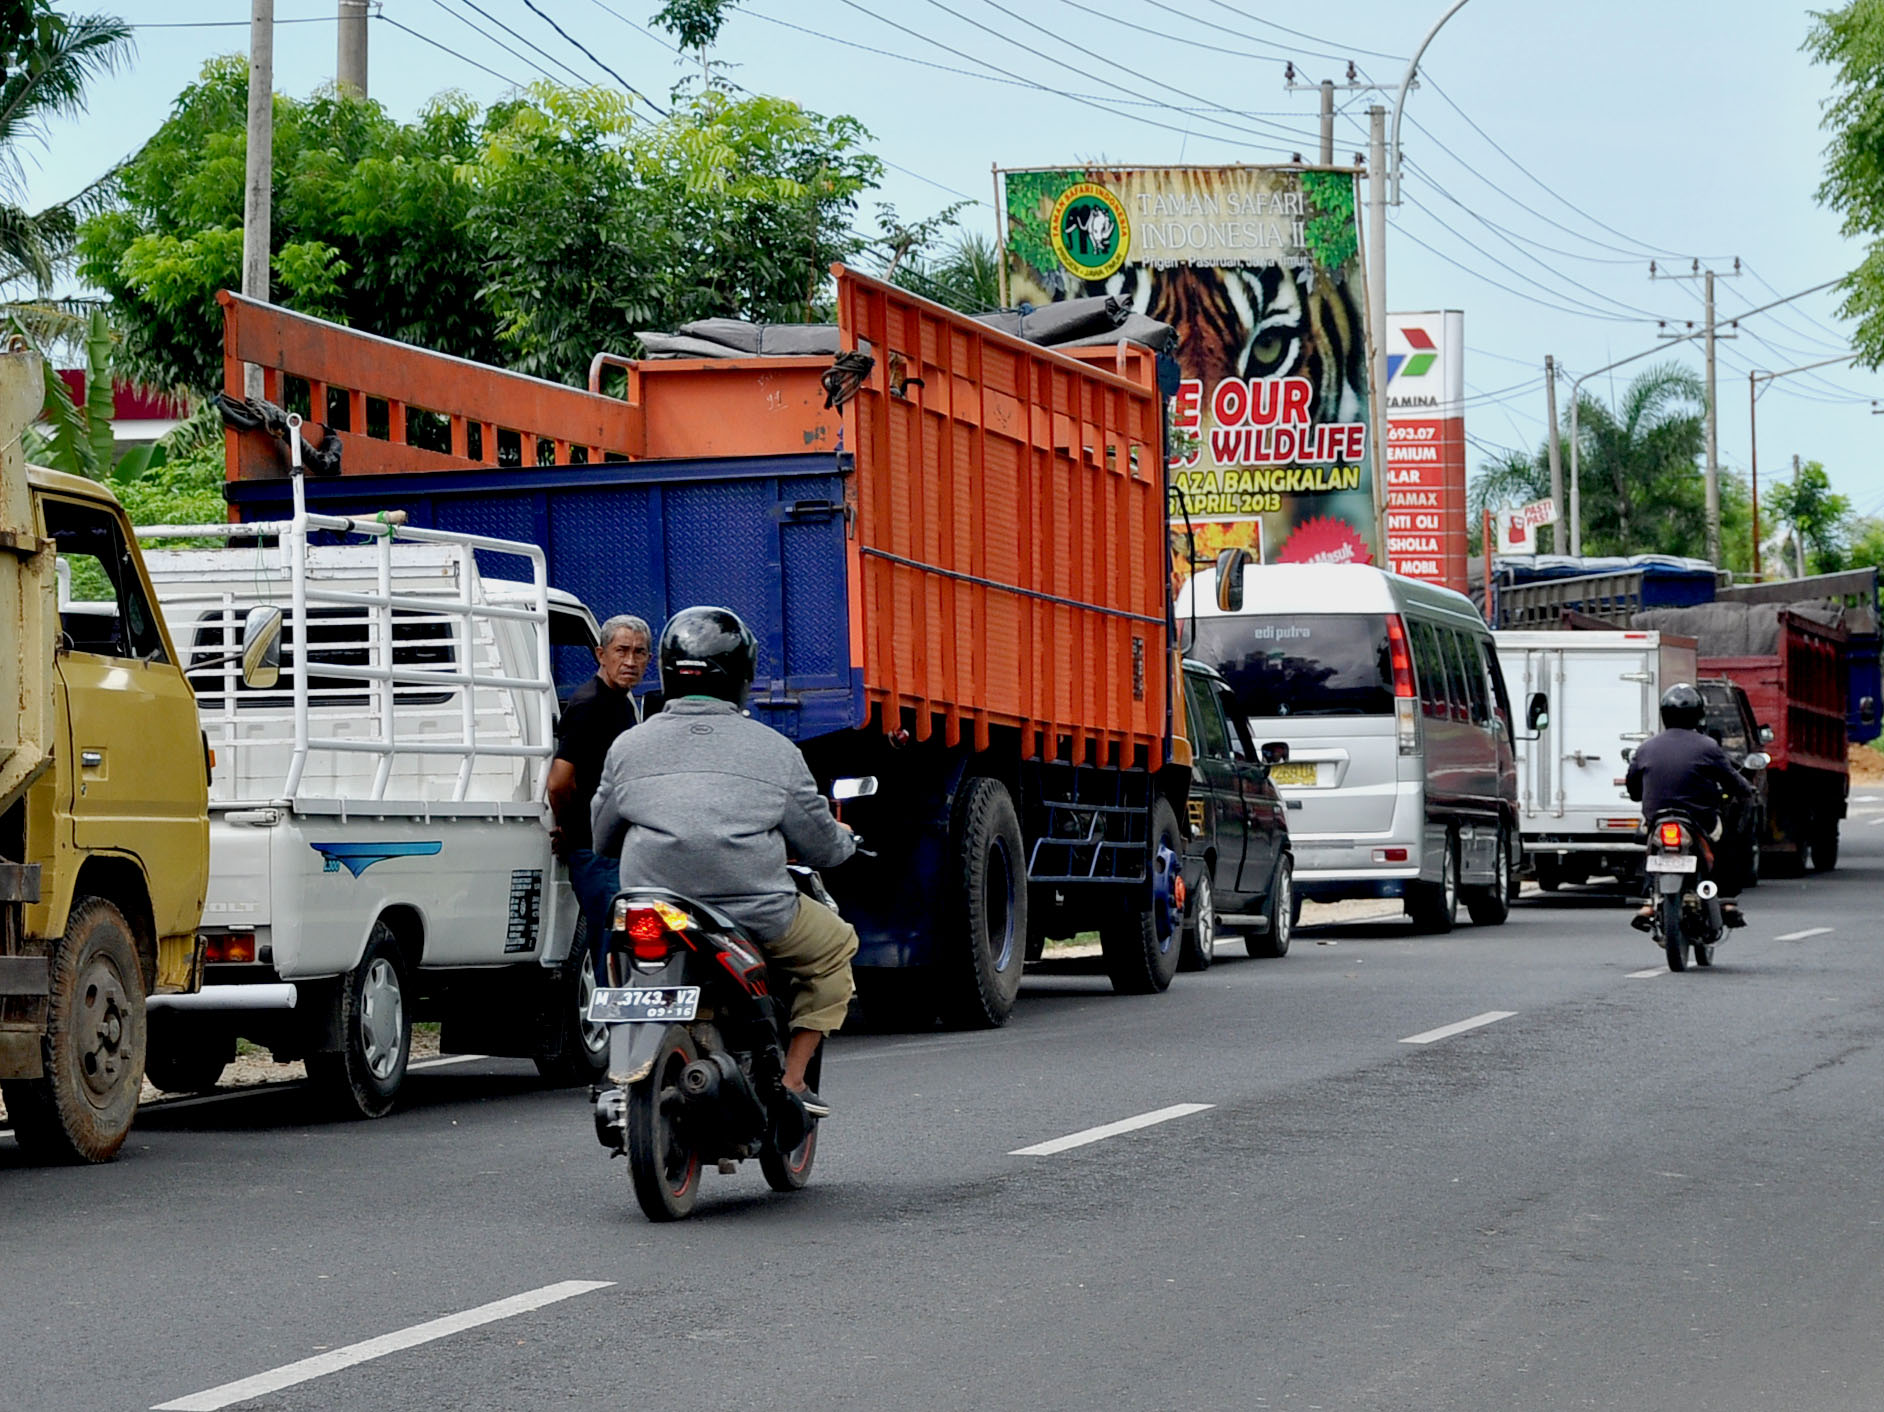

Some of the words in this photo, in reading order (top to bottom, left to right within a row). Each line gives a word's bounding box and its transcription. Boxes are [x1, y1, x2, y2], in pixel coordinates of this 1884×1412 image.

[1136, 192, 1220, 216] TAMAN
[1227, 192, 1304, 216] SAFARI
[1052, 200, 1066, 237] TAMAN
[1141, 221, 1284, 249] INDONESIA
[1291, 221, 1306, 248] II
[1142, 256, 1178, 271] Prigen
[1213, 378, 1311, 428] OUR
[1210, 425, 1365, 464] WILDLIFE
[1171, 470, 1218, 495] AZA
[1223, 466, 1360, 493] BANGKALAN
[1387, 469, 1420, 483] LAR
[1179, 494, 1237, 514] APRIL
[1240, 493, 1281, 512] 2013
[1388, 492, 1438, 506] TAMAX
[1525, 501, 1552, 517] PASTI
[1416, 515, 1439, 529] OLI
[1400, 560, 1439, 574] MOBIL
[207, 902, 260, 912] OLT
[676, 989, 698, 1005] VZ
